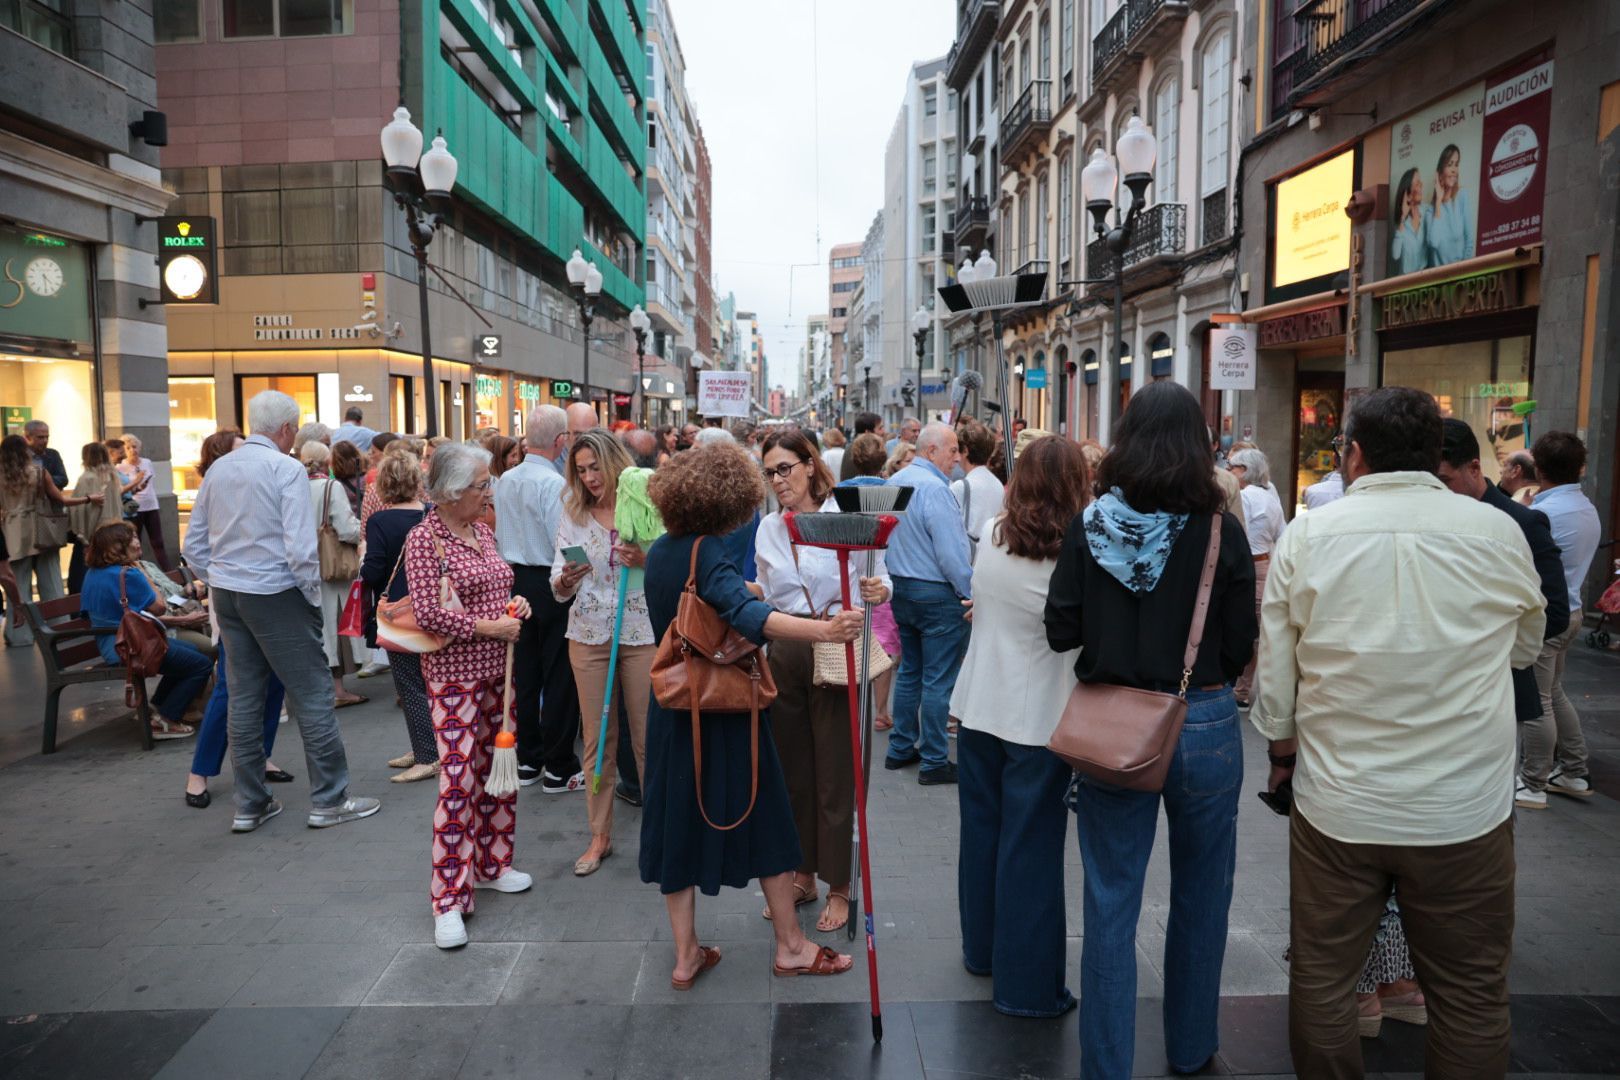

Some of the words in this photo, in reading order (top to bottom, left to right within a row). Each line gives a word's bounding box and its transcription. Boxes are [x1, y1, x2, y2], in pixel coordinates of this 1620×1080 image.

[1429, 109, 1465, 135] REVISA
[1469, 100, 1484, 117] TU
[1489, 69, 1549, 109] AUDICIÓN
[164, 237, 205, 246] ROLEX
[1383, 284, 1450, 329] HERRERA
[1453, 270, 1512, 315] CERPA
[255, 315, 291, 326] CALLE
[1218, 360, 1249, 369] Herrera
[1221, 369, 1245, 378] Cerpa
